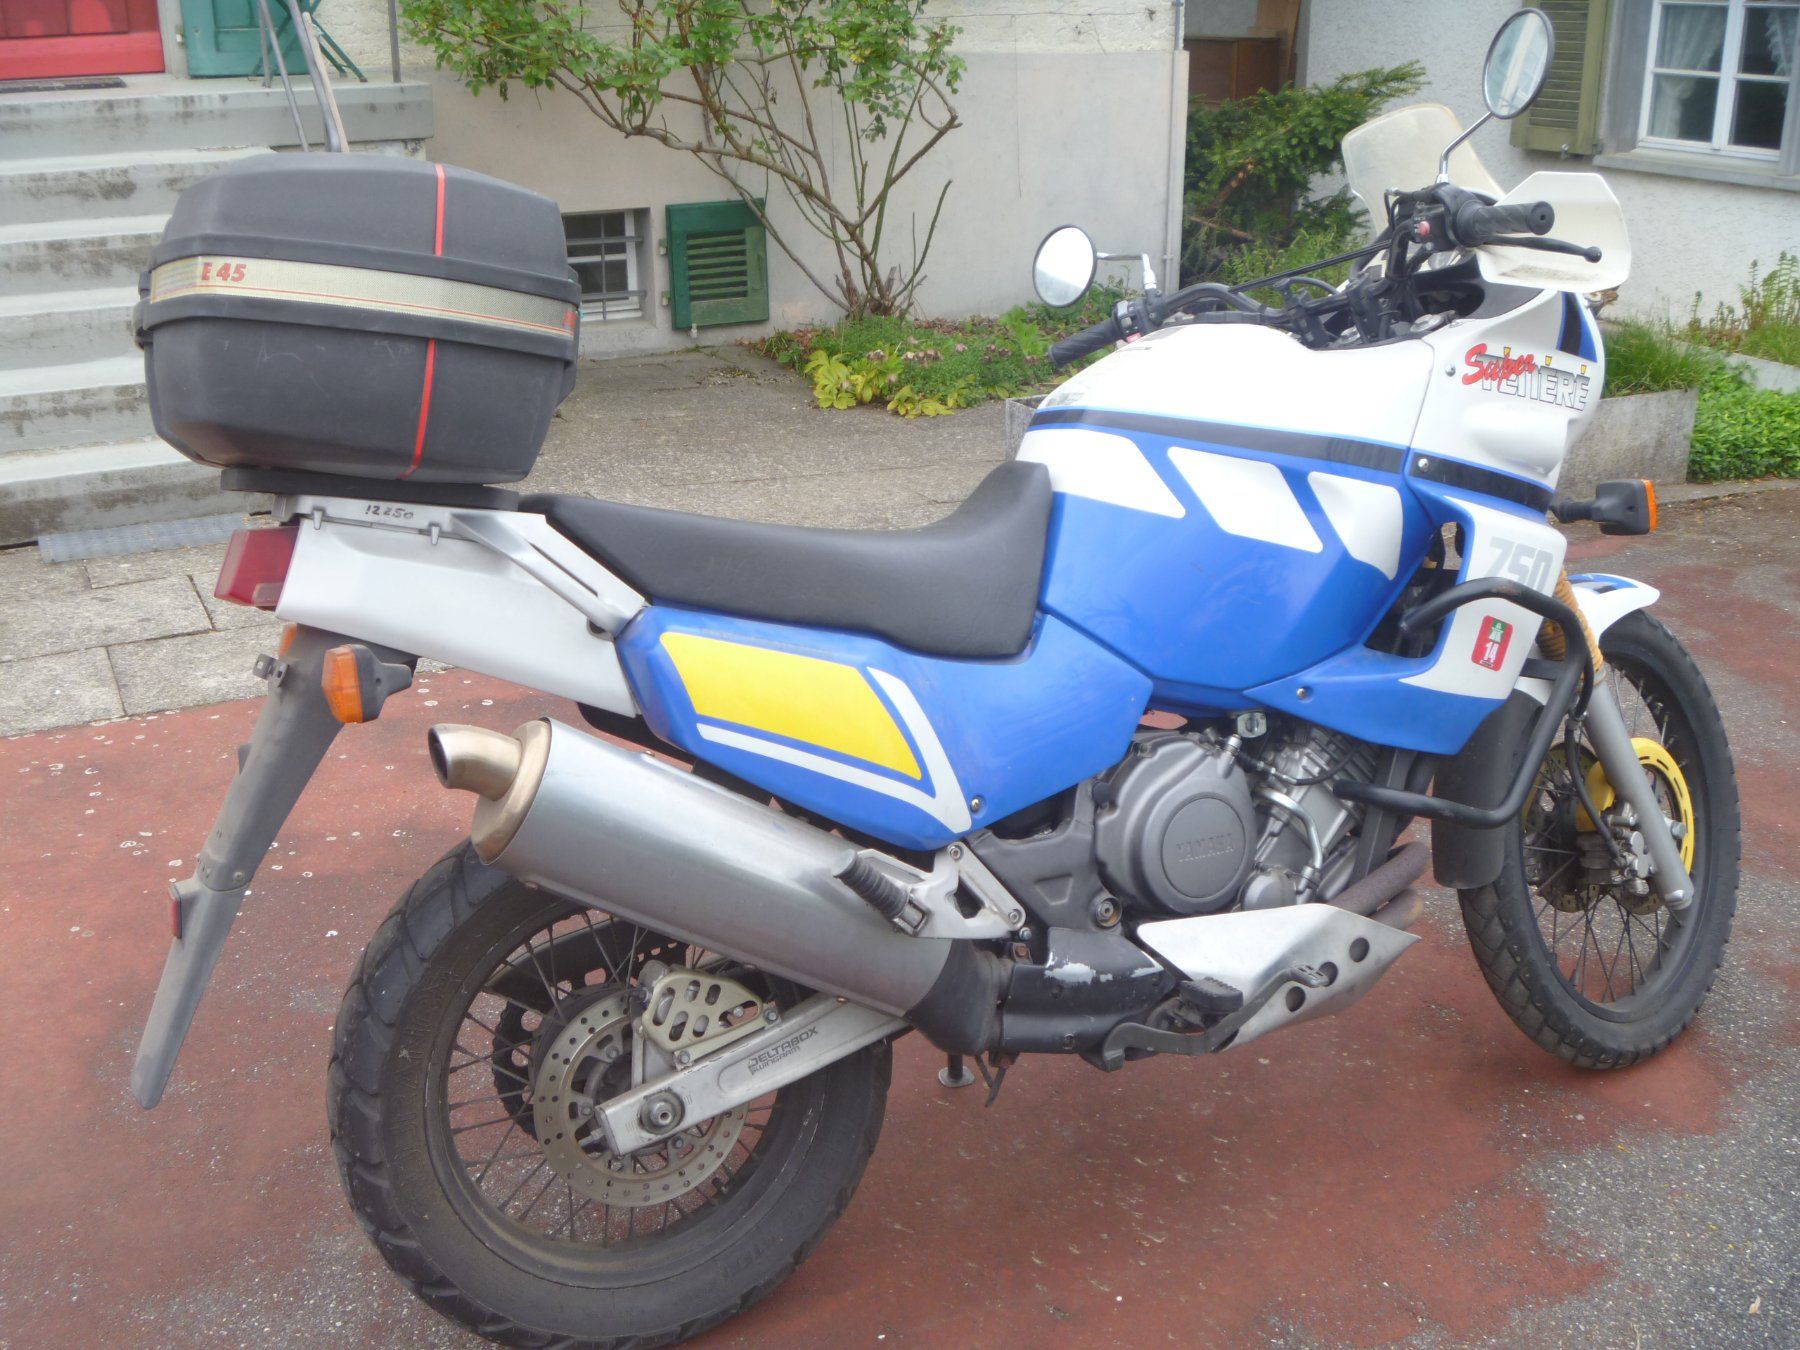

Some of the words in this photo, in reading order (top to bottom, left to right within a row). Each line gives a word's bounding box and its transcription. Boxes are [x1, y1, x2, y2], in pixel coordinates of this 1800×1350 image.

[201, 261, 213, 281] E
[216, 262, 247, 283] 45
[1461, 343, 1538, 392] Super
[1484, 536, 1554, 592] 750
[1483, 641, 1500, 663] 14
[1176, 832, 1234, 863] YAMAHA
[748, 1026, 818, 1070] DELTABOX
